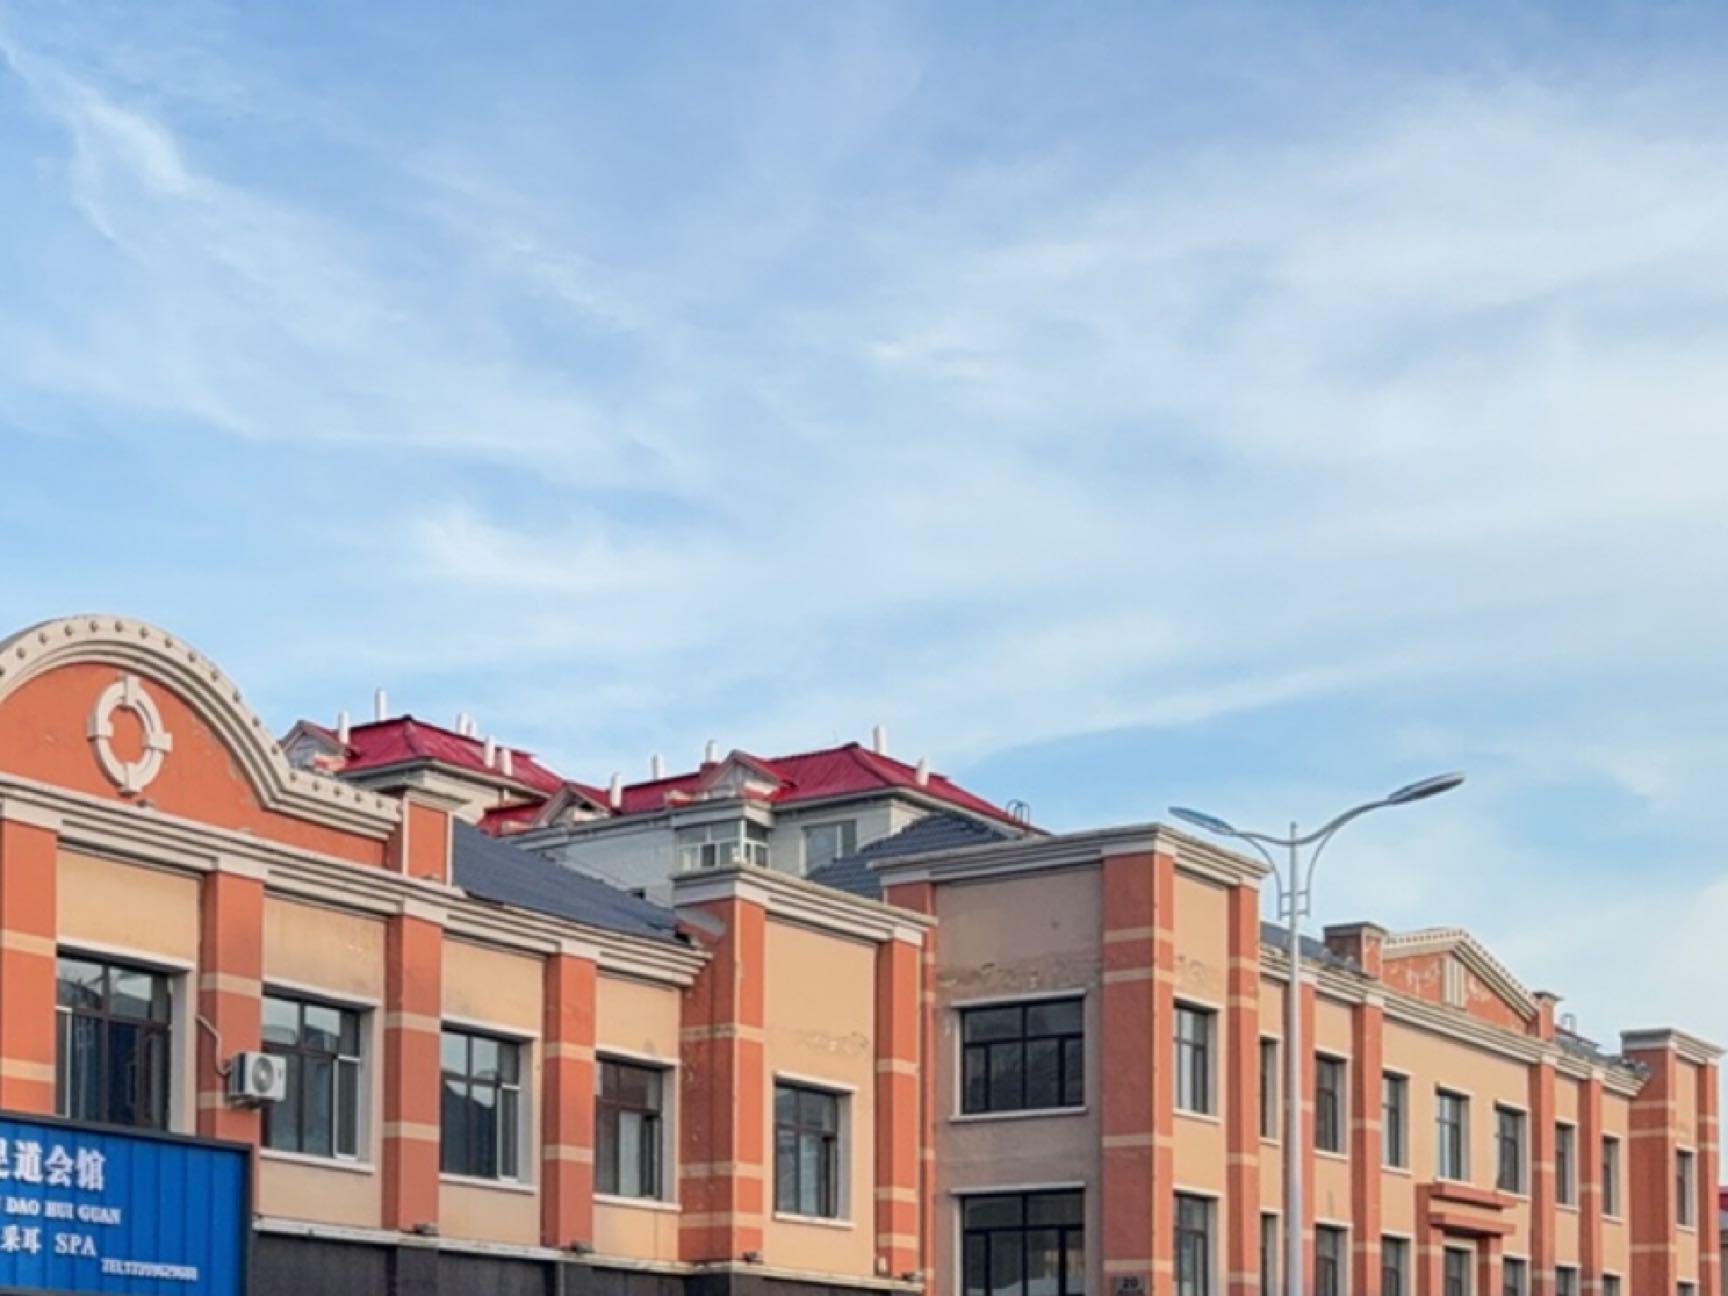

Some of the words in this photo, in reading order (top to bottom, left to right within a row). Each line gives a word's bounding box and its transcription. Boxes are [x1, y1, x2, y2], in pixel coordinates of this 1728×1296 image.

[6, 1196, 41, 1217] DAO
[44, 1200, 74, 1220] HUI
[77, 1203, 122, 1226] GUAN
[0, 1224, 43, 1255] 采耳
[54, 1231, 97, 1258] SPA
